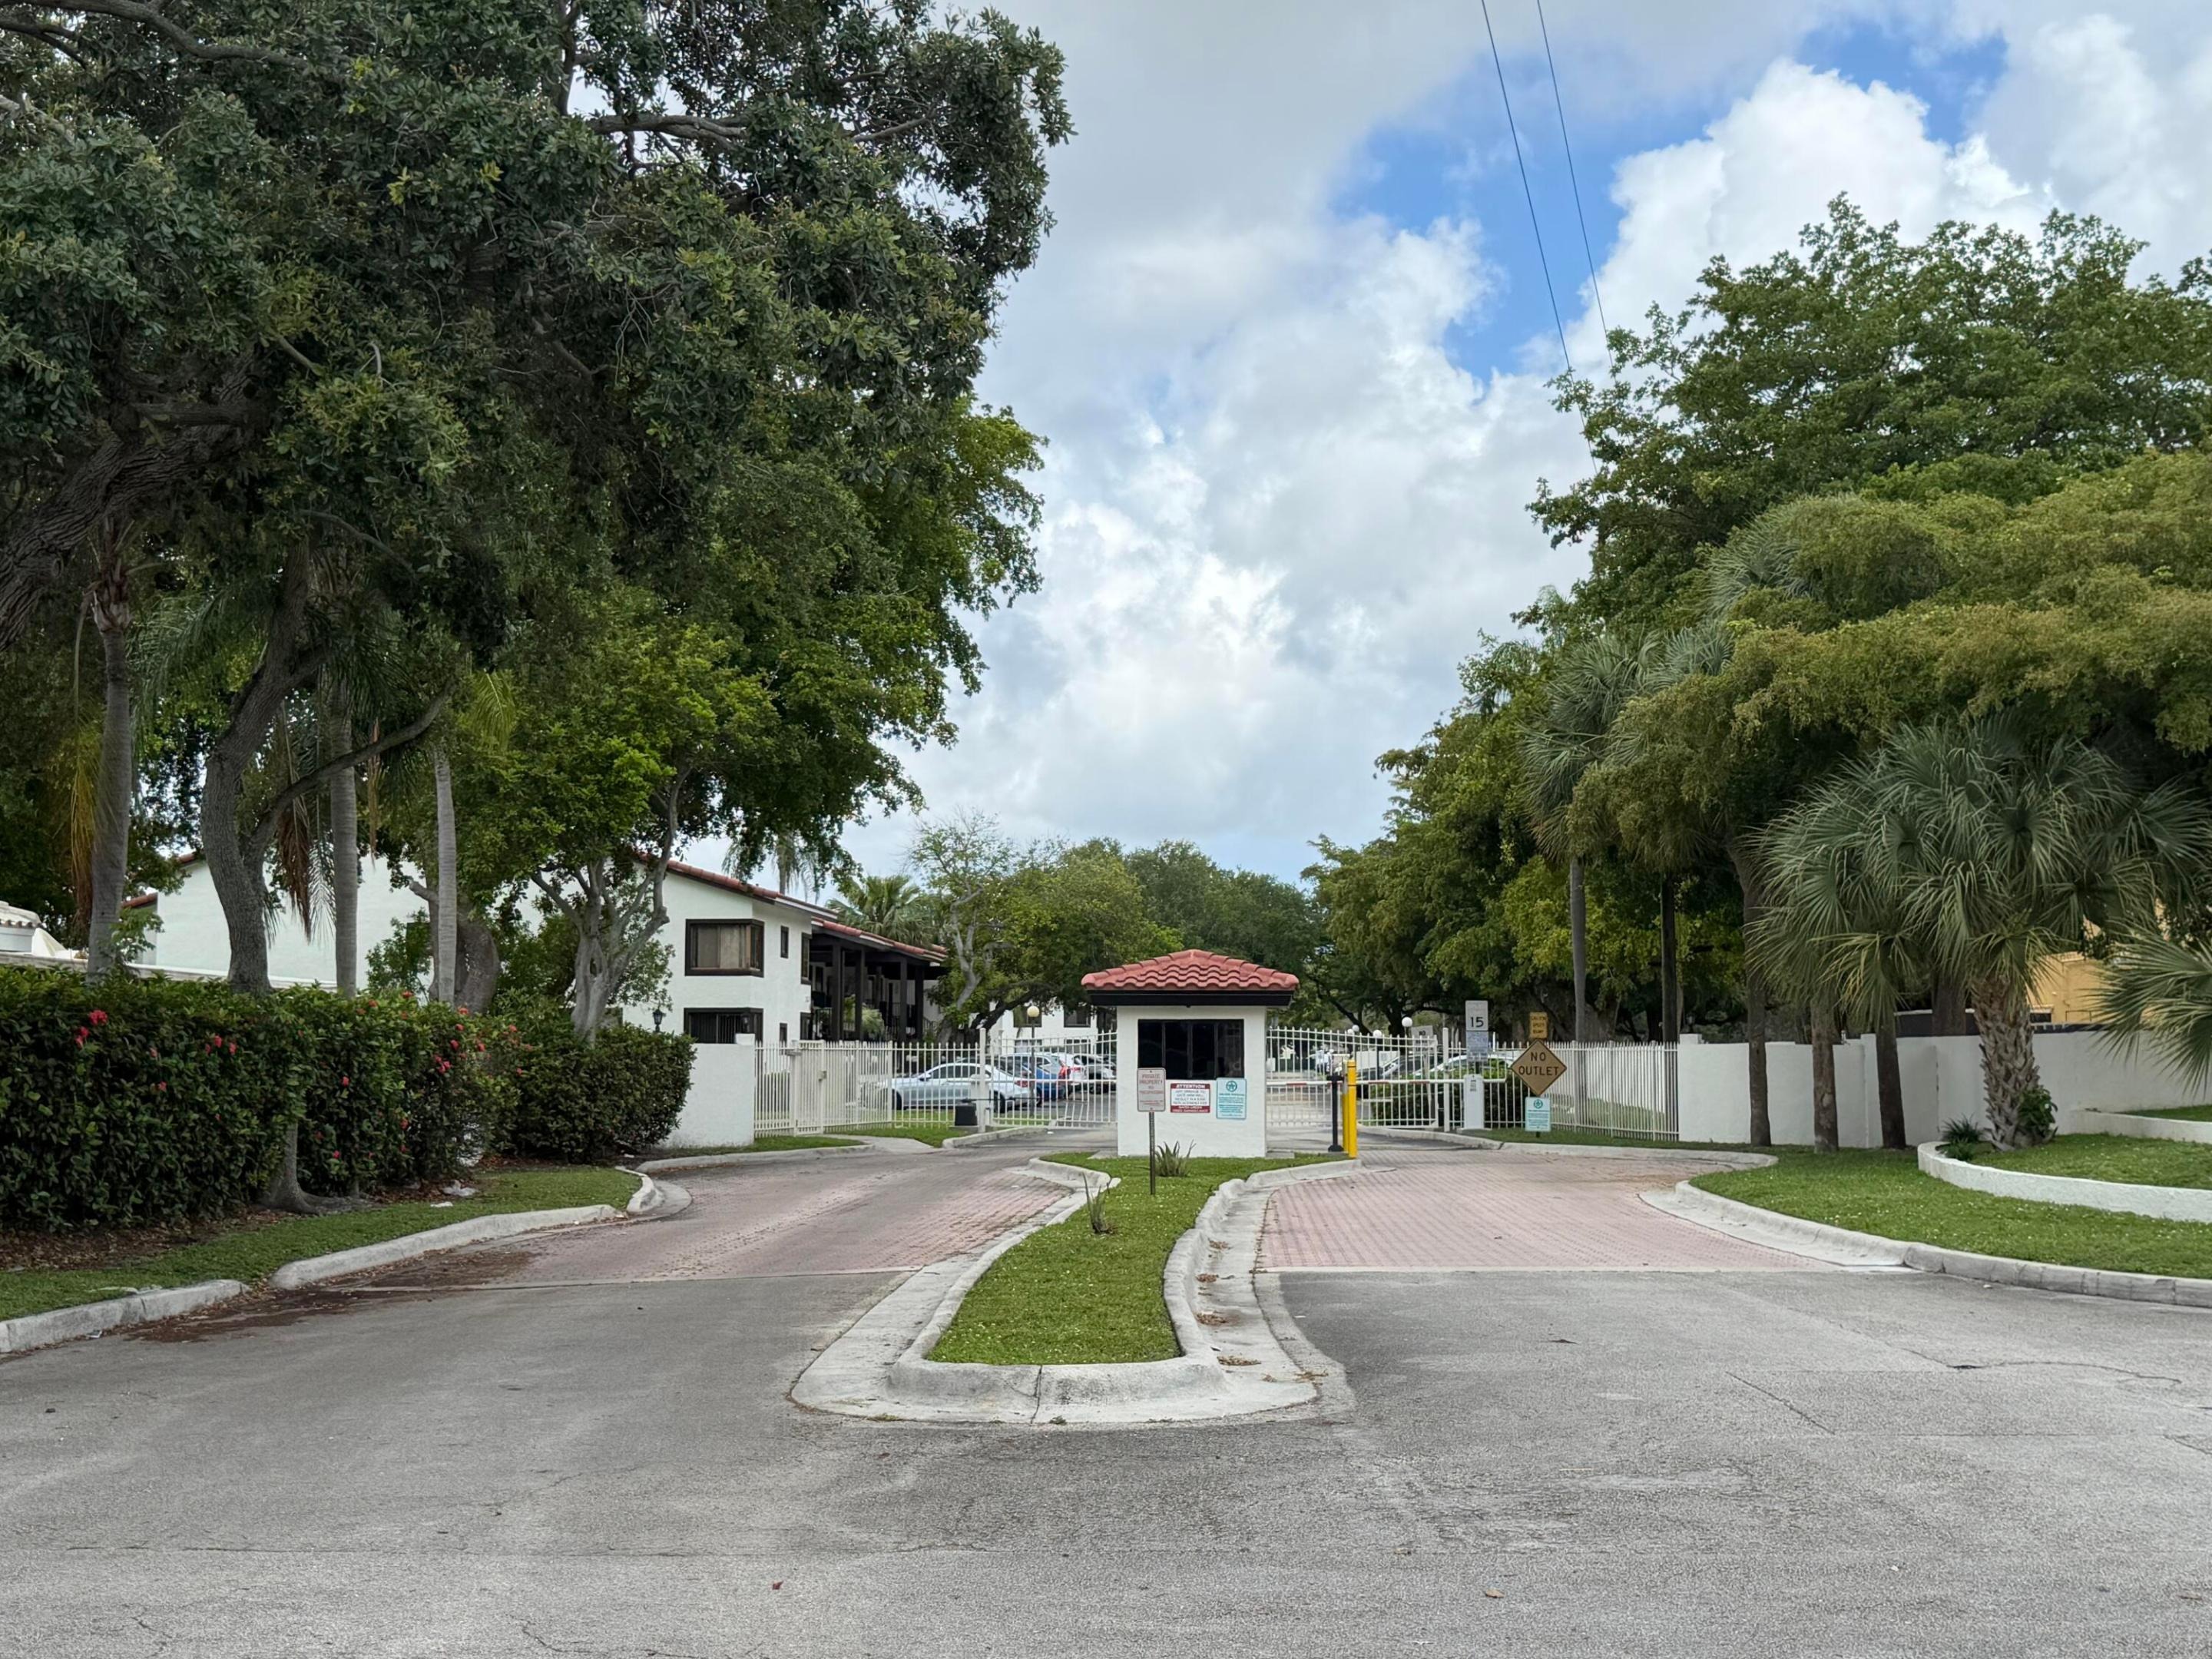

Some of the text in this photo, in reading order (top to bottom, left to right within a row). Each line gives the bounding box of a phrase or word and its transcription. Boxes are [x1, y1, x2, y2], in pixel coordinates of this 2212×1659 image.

[1470, 1016, 1484, 1028] 15
[1530, 1051, 1546, 1061] NO
[1518, 1065, 1559, 1076] OUTLET
